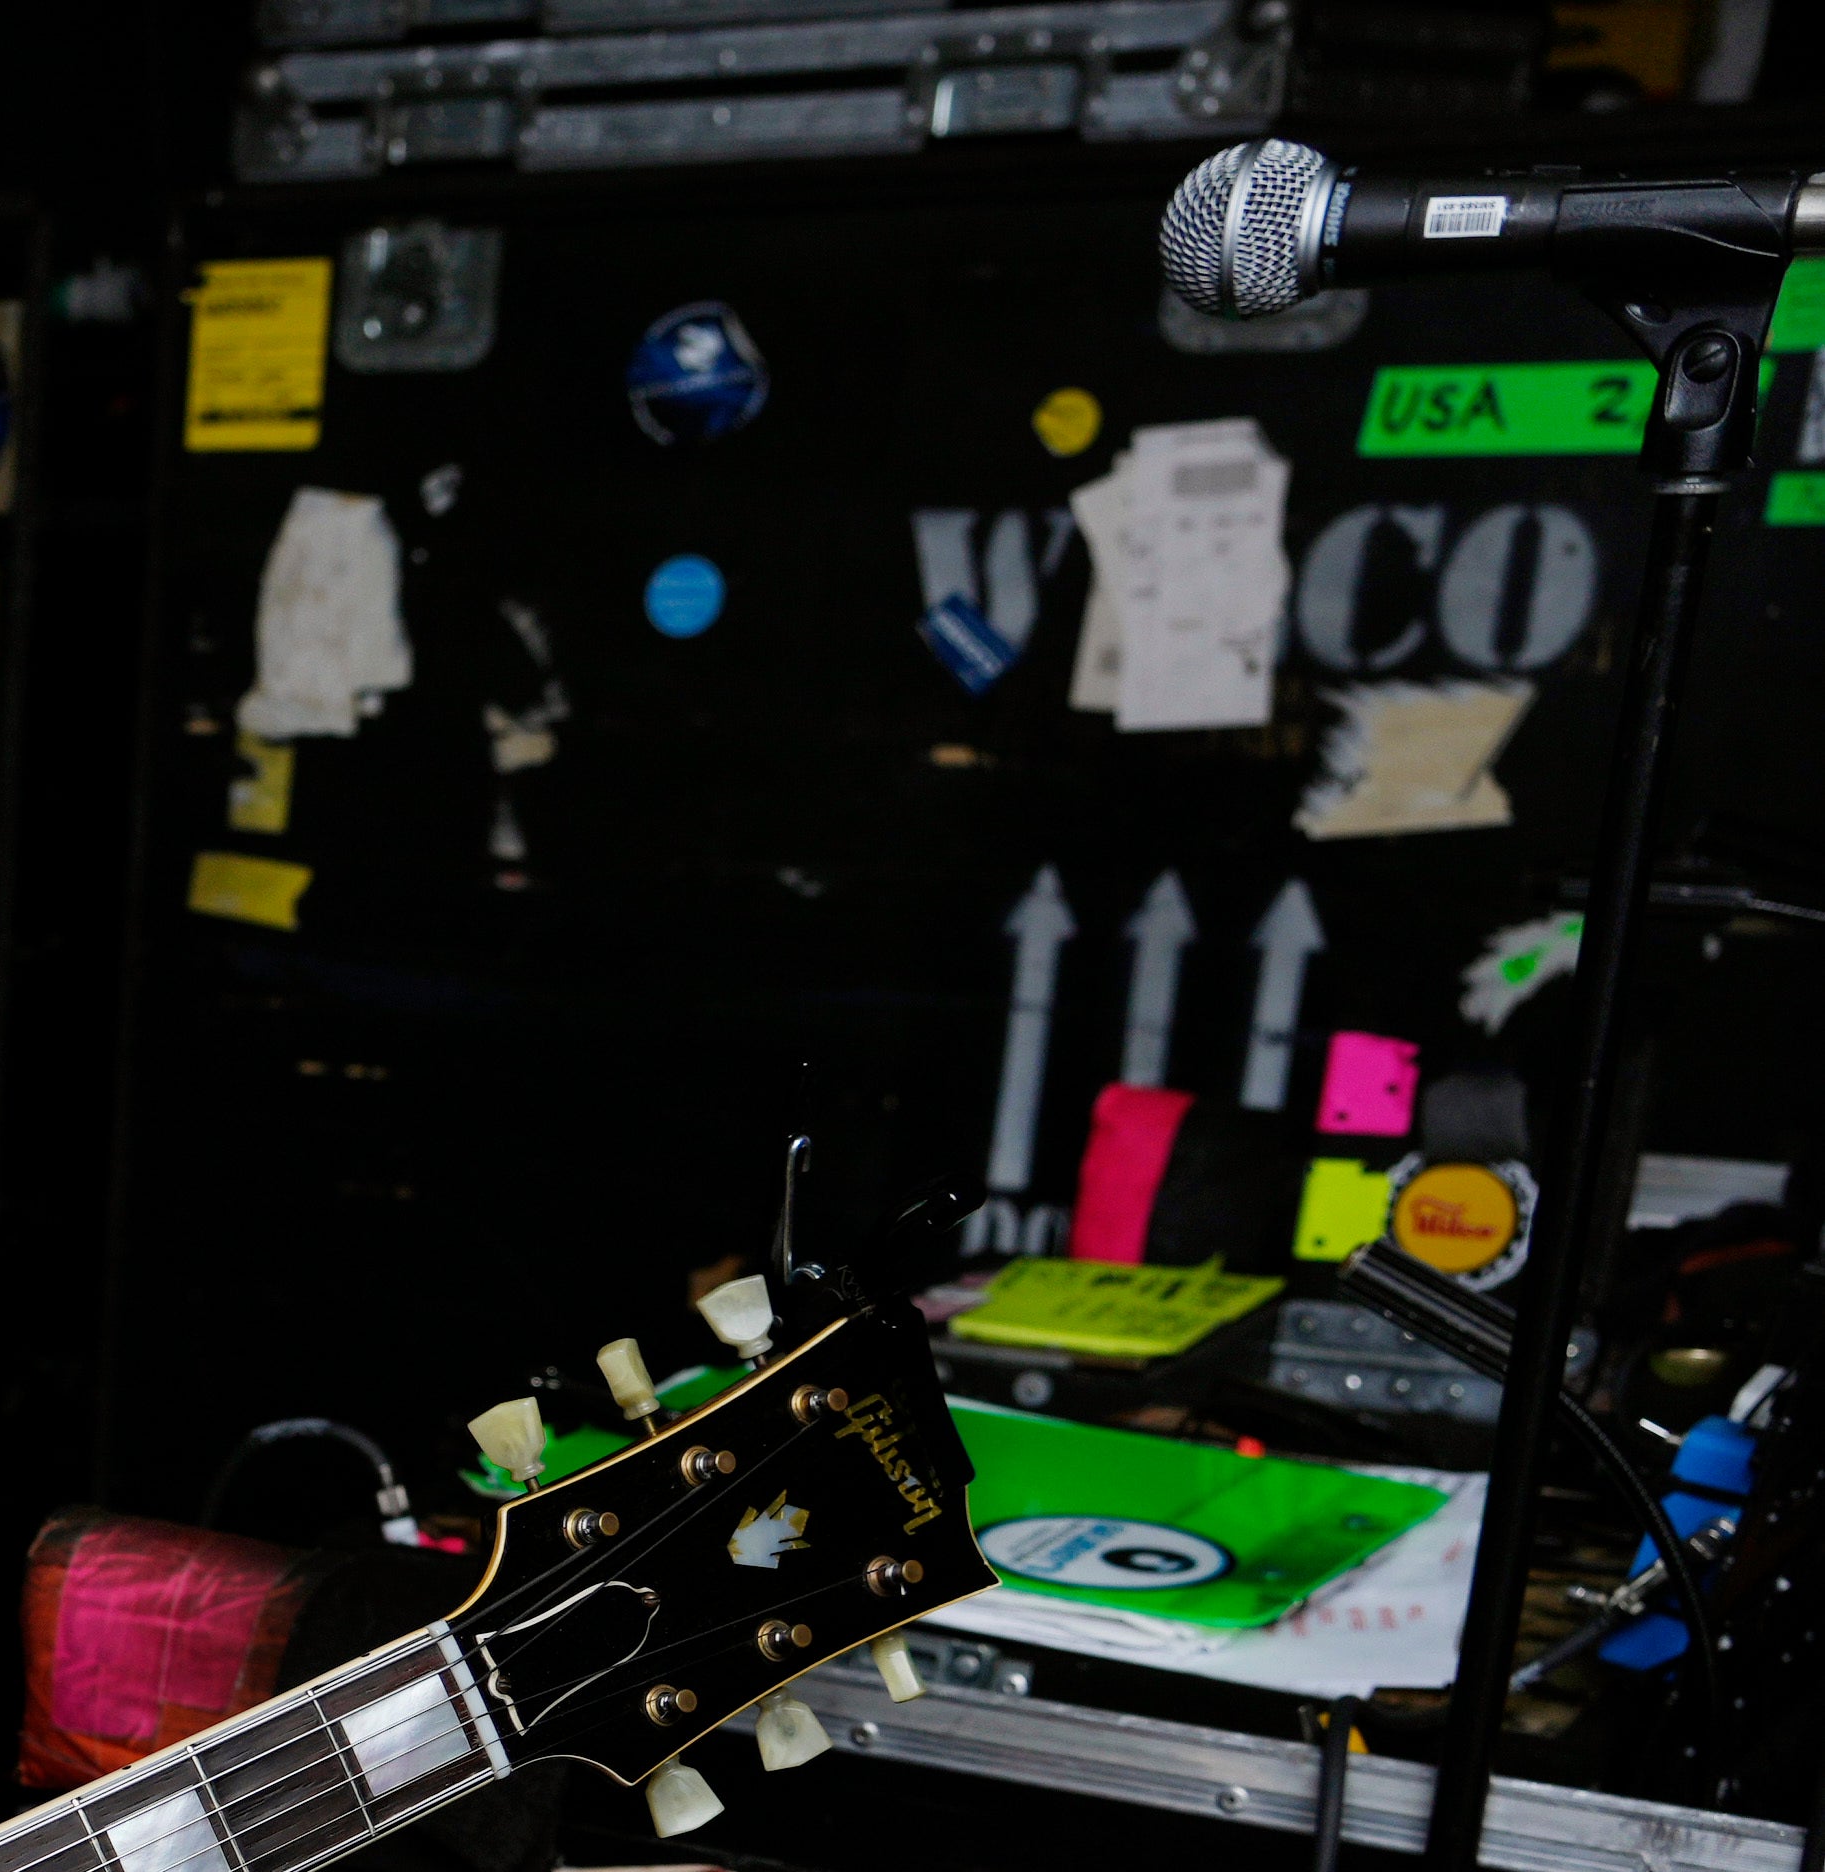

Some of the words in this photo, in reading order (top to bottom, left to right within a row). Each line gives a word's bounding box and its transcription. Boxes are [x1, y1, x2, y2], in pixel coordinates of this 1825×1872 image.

[1379, 376, 1507, 436] USA
[912, 500, 1599, 674] WCO
[834, 1392, 943, 1537] Gibson
